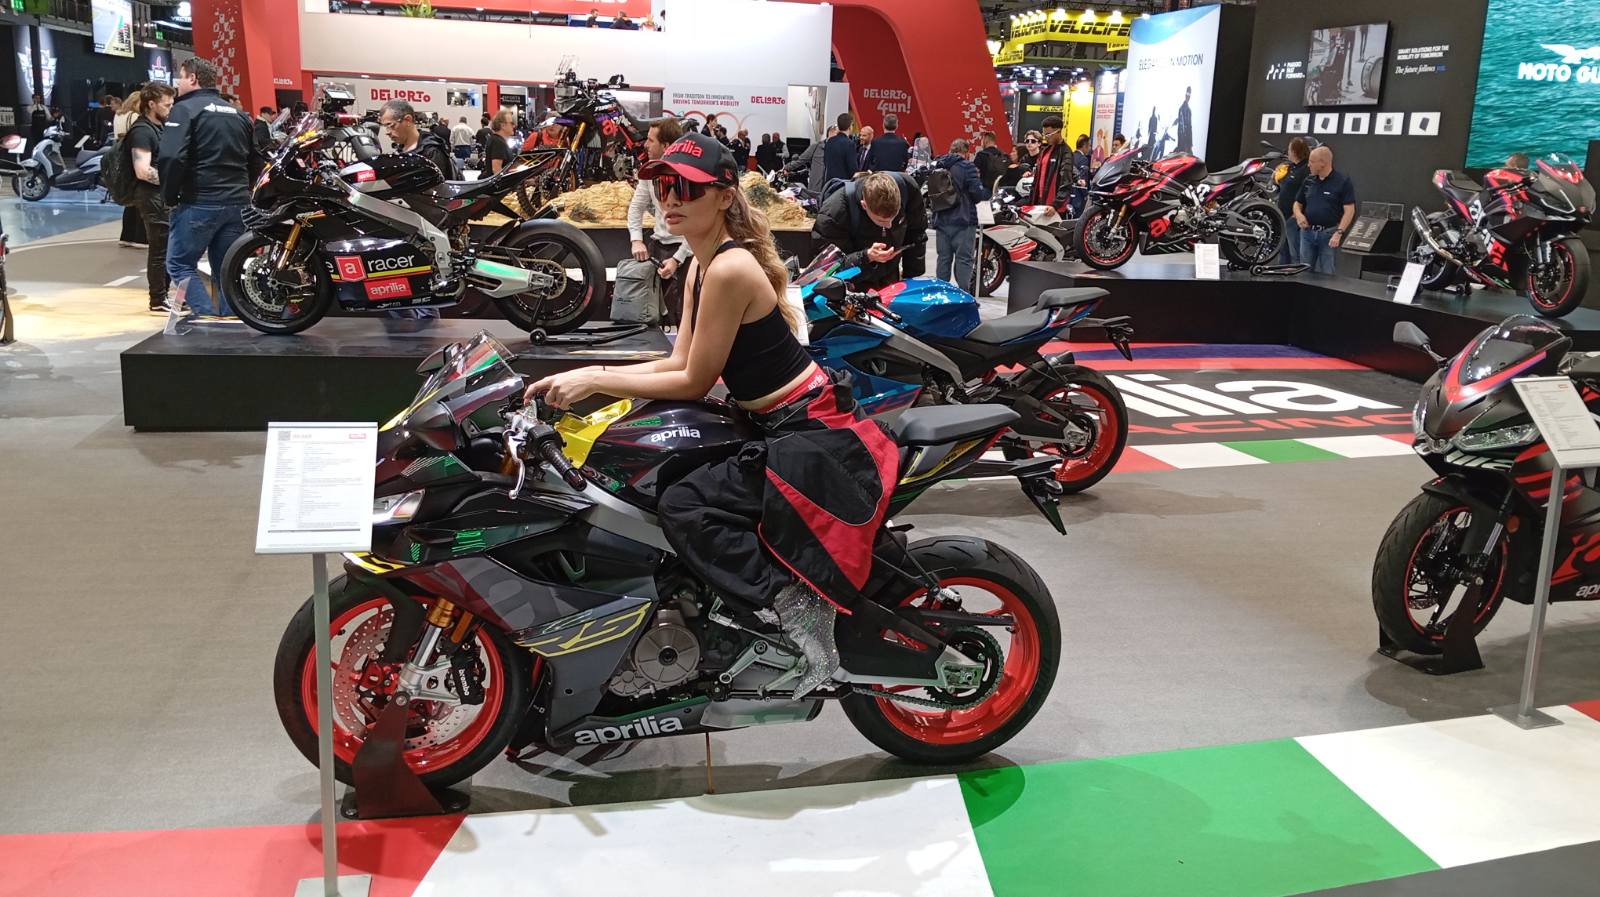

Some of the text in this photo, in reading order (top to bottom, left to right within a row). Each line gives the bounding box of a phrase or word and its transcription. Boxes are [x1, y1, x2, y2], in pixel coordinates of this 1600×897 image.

[1049, 20, 1130, 37] VELOCIFE
[1176, 53, 1204, 67] MOTION
[1517, 61, 1572, 82] MOTO
[367, 255, 415, 272] racer
[370, 282, 407, 296] aprilia
[650, 426, 701, 443] aprilia
[458, 668, 471, 697] brembo
[574, 715, 684, 745] aprilia
